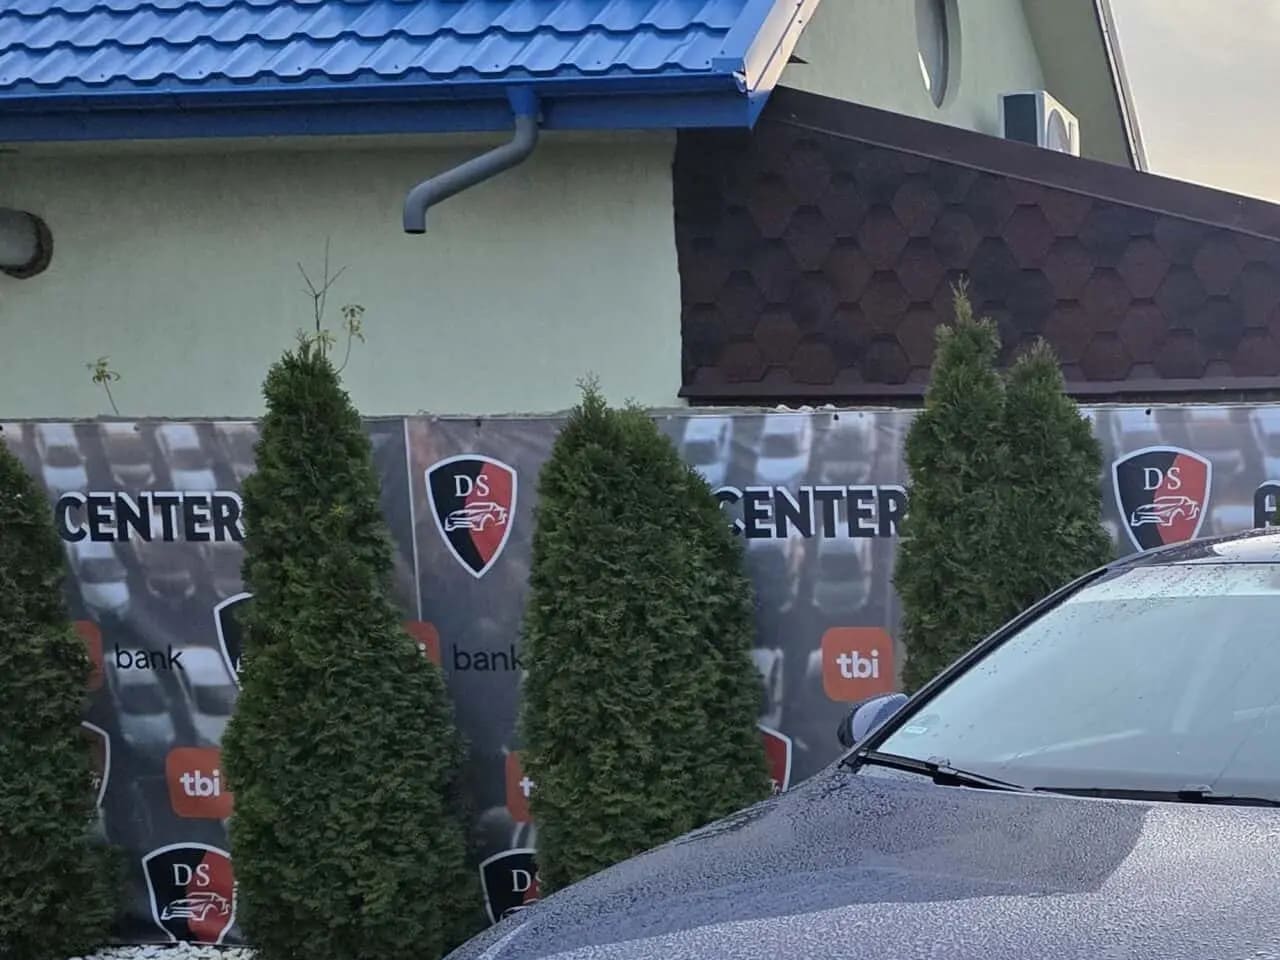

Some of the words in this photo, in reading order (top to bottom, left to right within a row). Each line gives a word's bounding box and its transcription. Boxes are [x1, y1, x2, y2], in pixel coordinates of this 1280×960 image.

[454, 474, 490, 498] DS
[1143, 466, 1183, 491] DS
[55, 491, 247, 542] CENTER
[114, 643, 184, 671] bank
[452, 644, 523, 672] bank
[836, 649, 880, 679] tbi
[179, 769, 221, 797] tbi
[172, 862, 211, 887] DS
